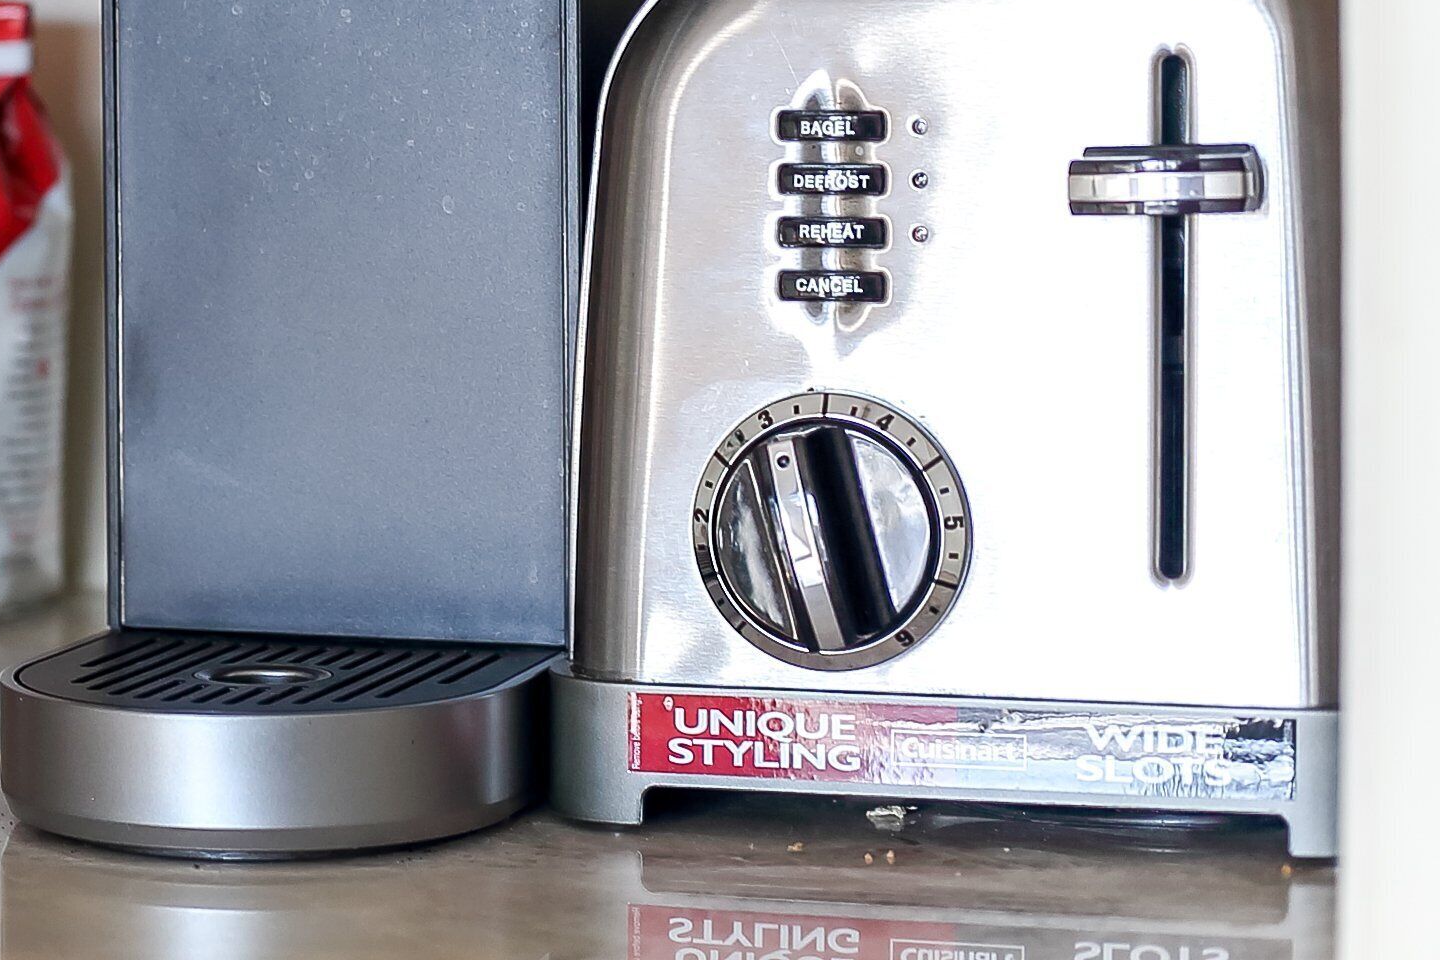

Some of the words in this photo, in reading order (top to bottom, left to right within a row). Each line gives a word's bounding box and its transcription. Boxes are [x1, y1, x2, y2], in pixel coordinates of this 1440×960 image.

[800, 120, 856, 137] BAGEL
[793, 173, 871, 192] DEFROST
[799, 222, 865, 241] REHEAT
[795, 277, 864, 295] CANCEL
[757, 409, 774, 430] 3
[876, 413, 893, 431] 4
[694, 507, 710, 524] 2
[944, 516, 965, 531] 5
[674, 707, 857, 743] UNIQUE
[1085, 723, 1224, 755] WIDE
[667, 737, 861, 772] STYLING
[901, 736, 1018, 762] Cuisinart
[1075, 753, 1233, 787] SLOTS
